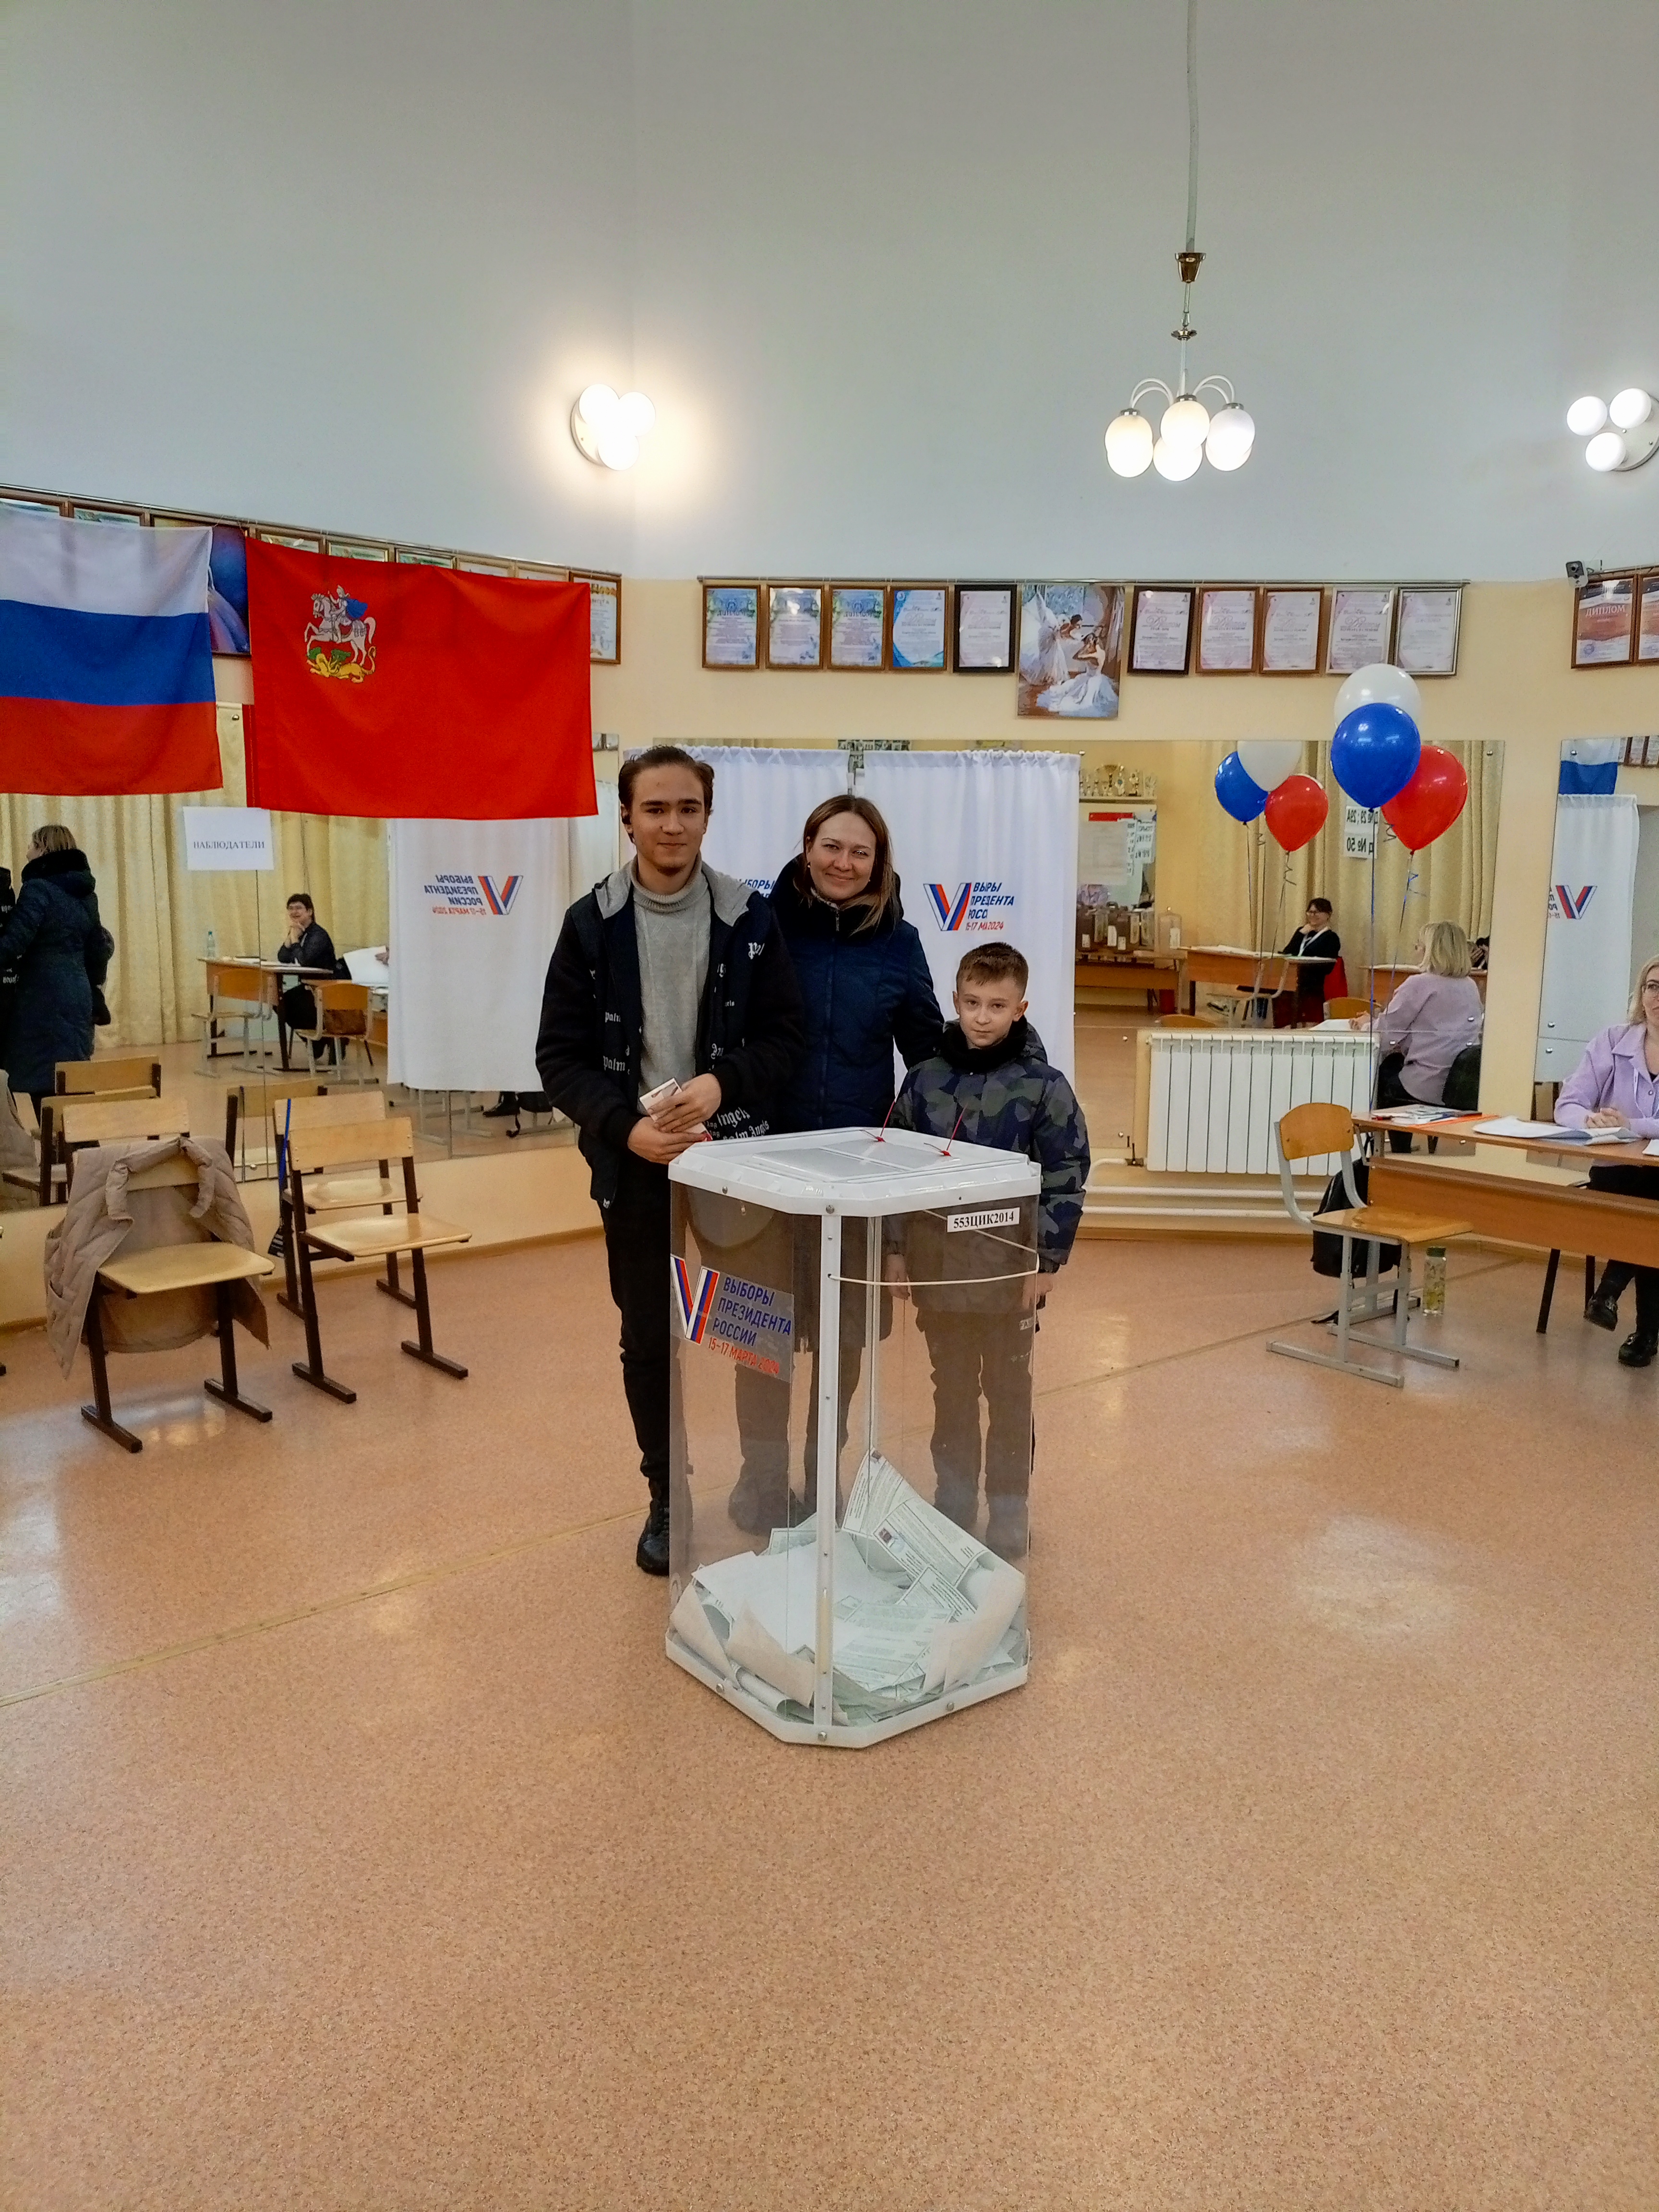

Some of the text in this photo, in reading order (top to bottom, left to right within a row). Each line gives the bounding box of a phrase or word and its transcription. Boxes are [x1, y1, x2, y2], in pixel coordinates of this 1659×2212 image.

[1586, 605, 1625, 618] ДИПЛОМ
[193, 841, 264, 849] НАБЛЮДАТЕЛИ
[953, 1211, 1014, 1228] 553ЦИК2014
[723, 1276, 775, 1306] ВЫБОРЫ
[717, 1297, 792, 1336] ПРЕЗИДЕНТА
[712, 1318, 757, 1346] РОССИИ
[729, 1346, 757, 1366] МАРТА
